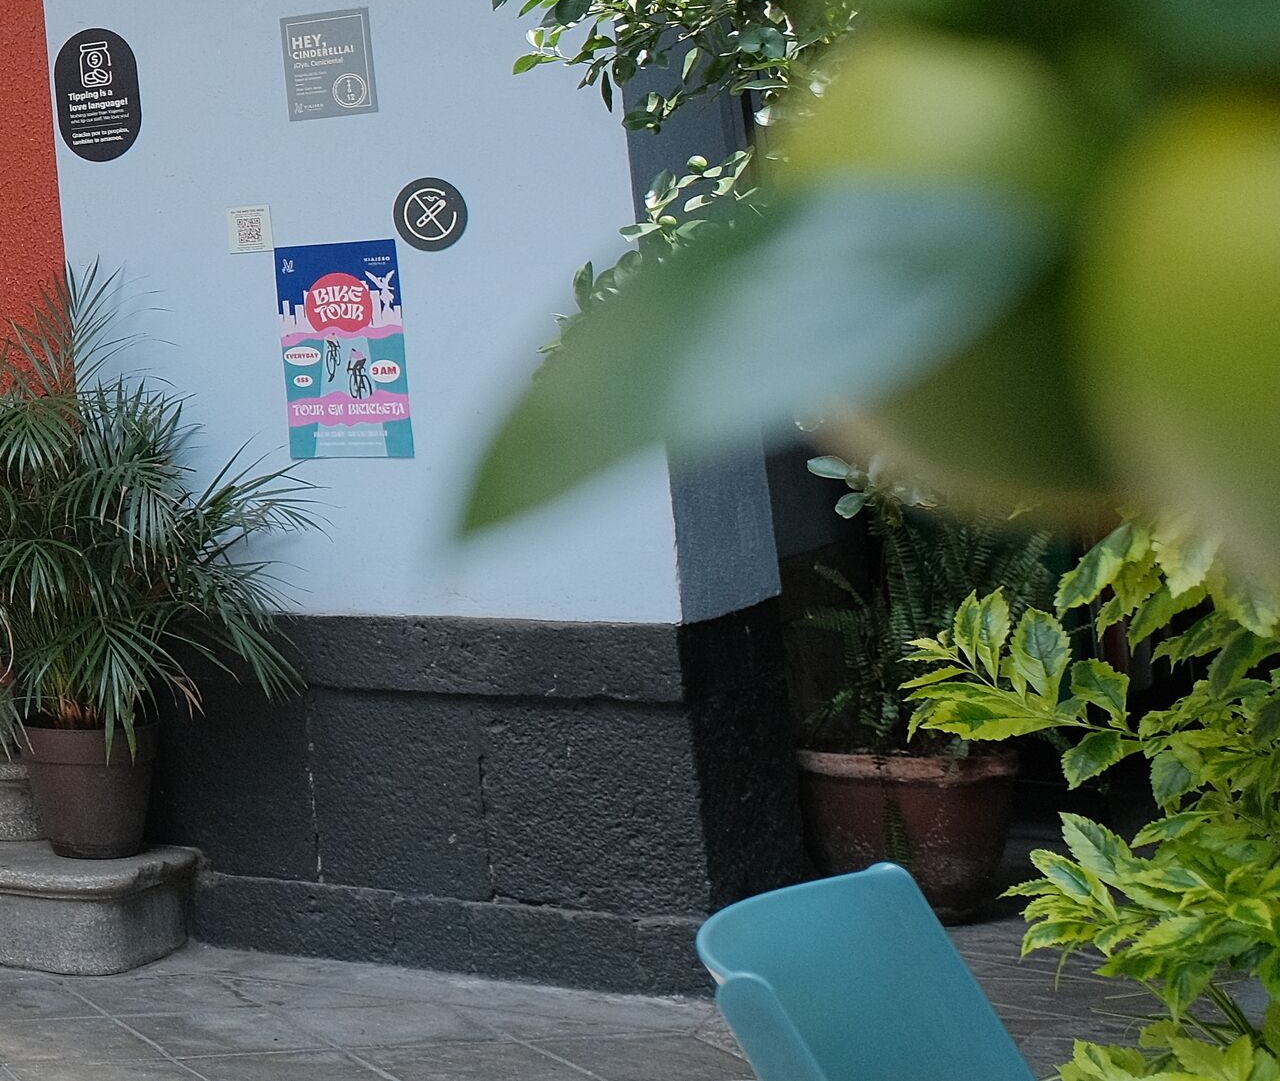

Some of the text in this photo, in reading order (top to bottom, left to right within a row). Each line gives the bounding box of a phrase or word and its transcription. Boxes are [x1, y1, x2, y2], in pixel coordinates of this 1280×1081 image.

[291, 34, 327, 49] HEY,
[292, 44, 354, 60] CINDERELLA!
[68, 91, 99, 102] Tipping
[99, 89, 106, 97] is
[69, 97, 128, 112] love language!
[312, 285, 364, 305] BIKE
[313, 303, 364, 323] TOUR
[371, 366, 397, 375] 9 AM
[292, 402, 405, 416] TOUR EN BICICLETA
